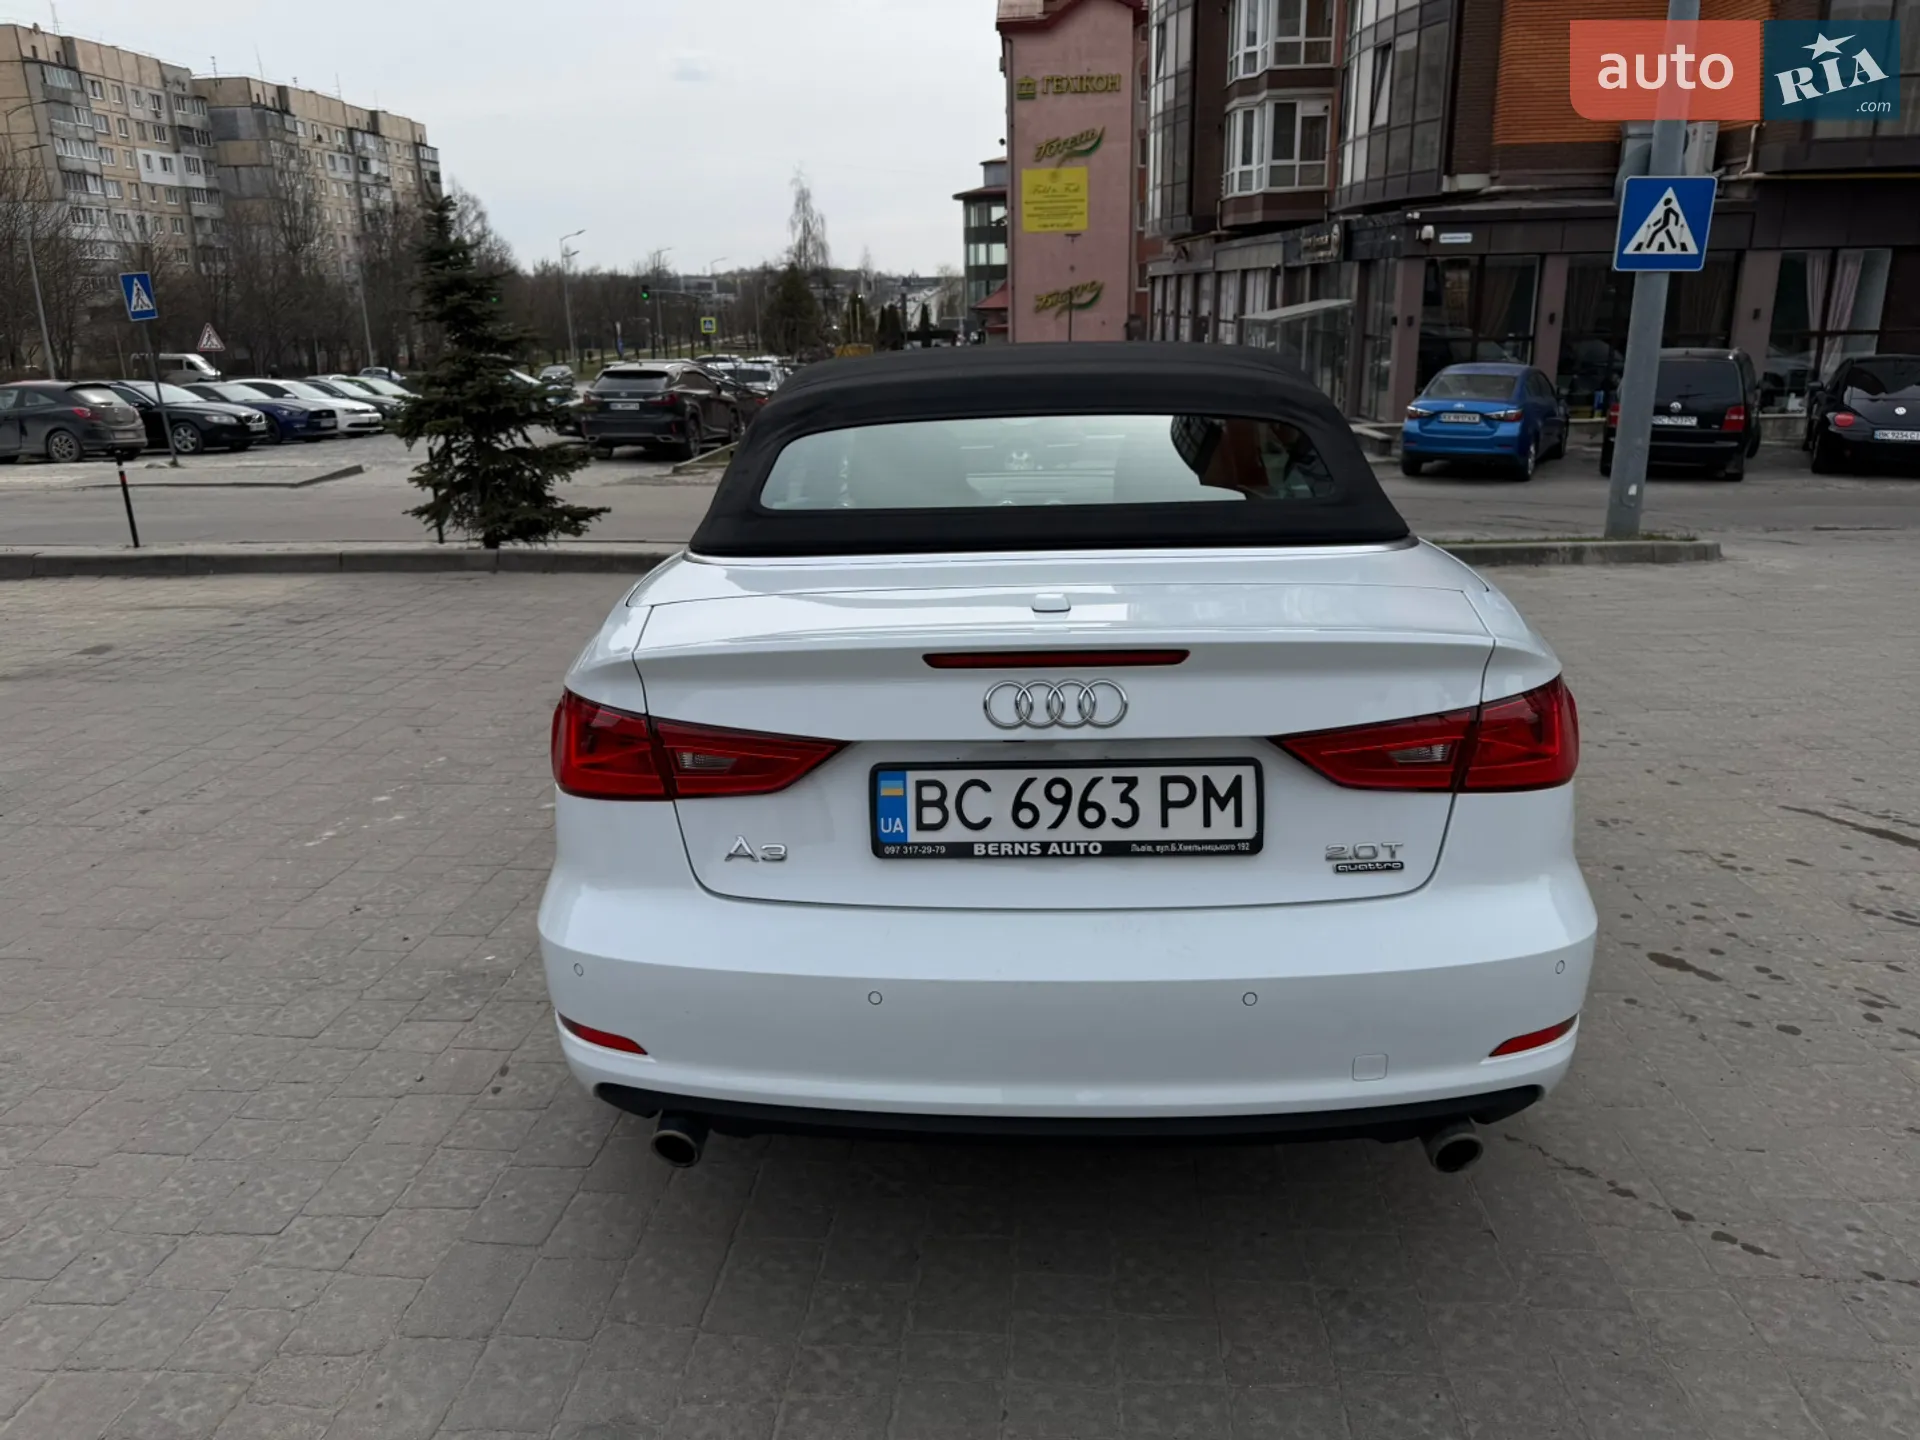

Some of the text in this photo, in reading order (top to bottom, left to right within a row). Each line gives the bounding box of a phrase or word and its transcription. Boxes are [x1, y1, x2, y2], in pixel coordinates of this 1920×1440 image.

[1041, 74, 1121, 95] ГЕЛІКОН
[914, 774, 1243, 831] BC 6963 PM
[880, 818, 904, 833] UA
[724, 835, 787, 862] A3
[884, 846, 900, 855] 097
[973, 842, 1103, 856] BERNS AUTO
[1325, 842, 1403, 861] 2.0T
[1337, 862, 1402, 872] quattro
